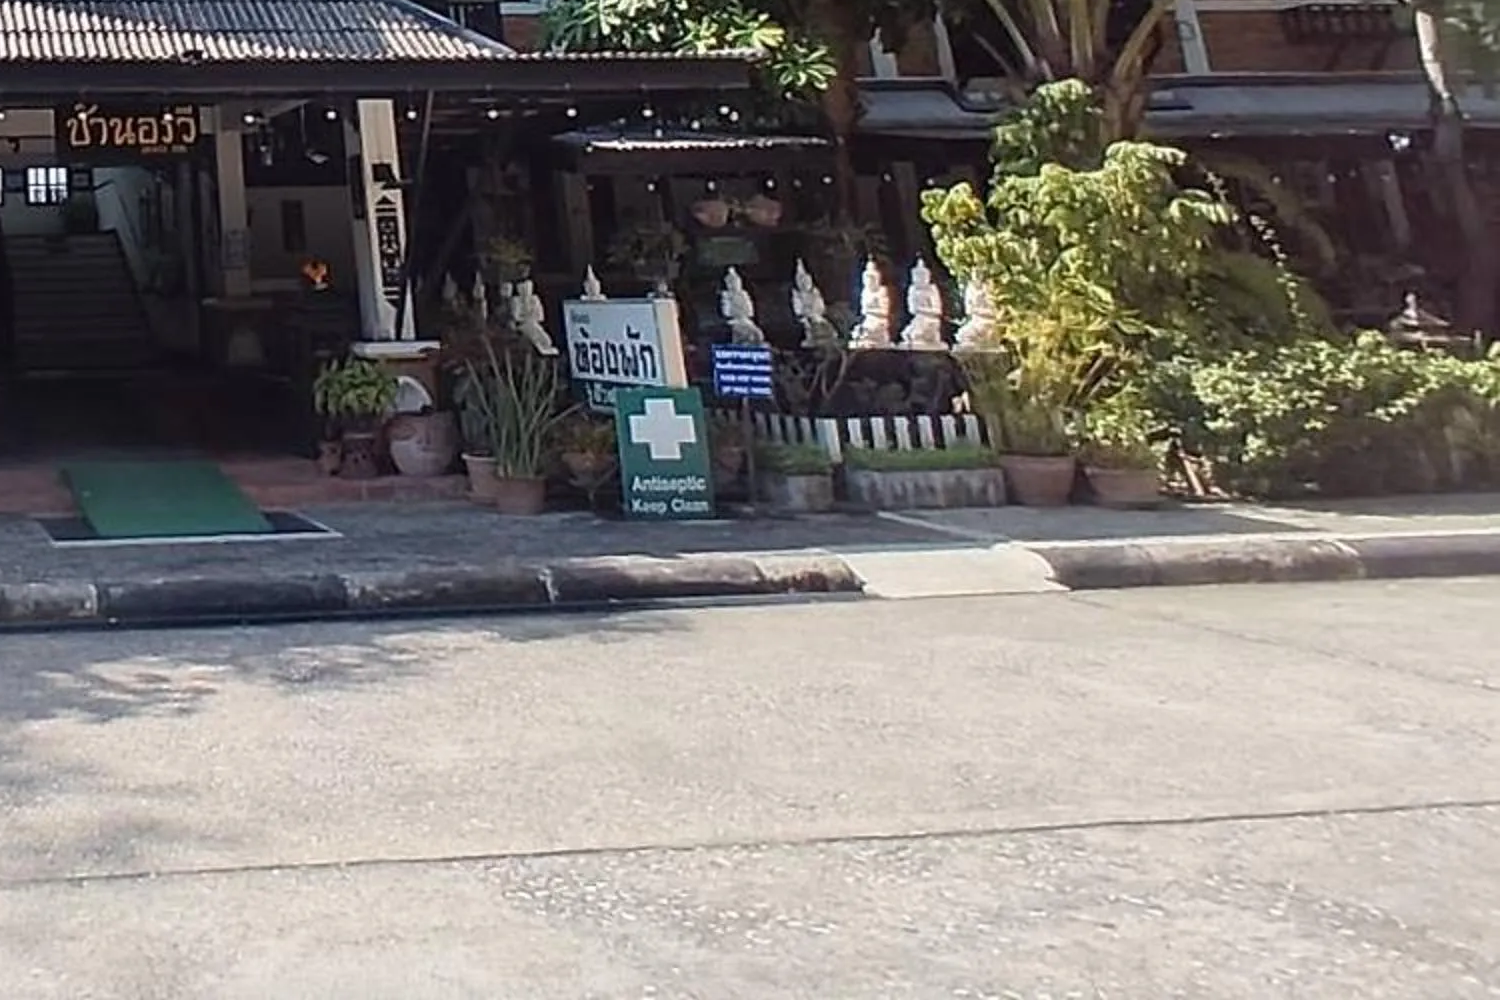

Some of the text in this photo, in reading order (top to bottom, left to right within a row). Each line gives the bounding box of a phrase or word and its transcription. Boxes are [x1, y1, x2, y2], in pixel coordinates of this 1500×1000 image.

[631, 475, 706, 495] Antiseptic
[631, 498, 709, 515] Keep Clean
